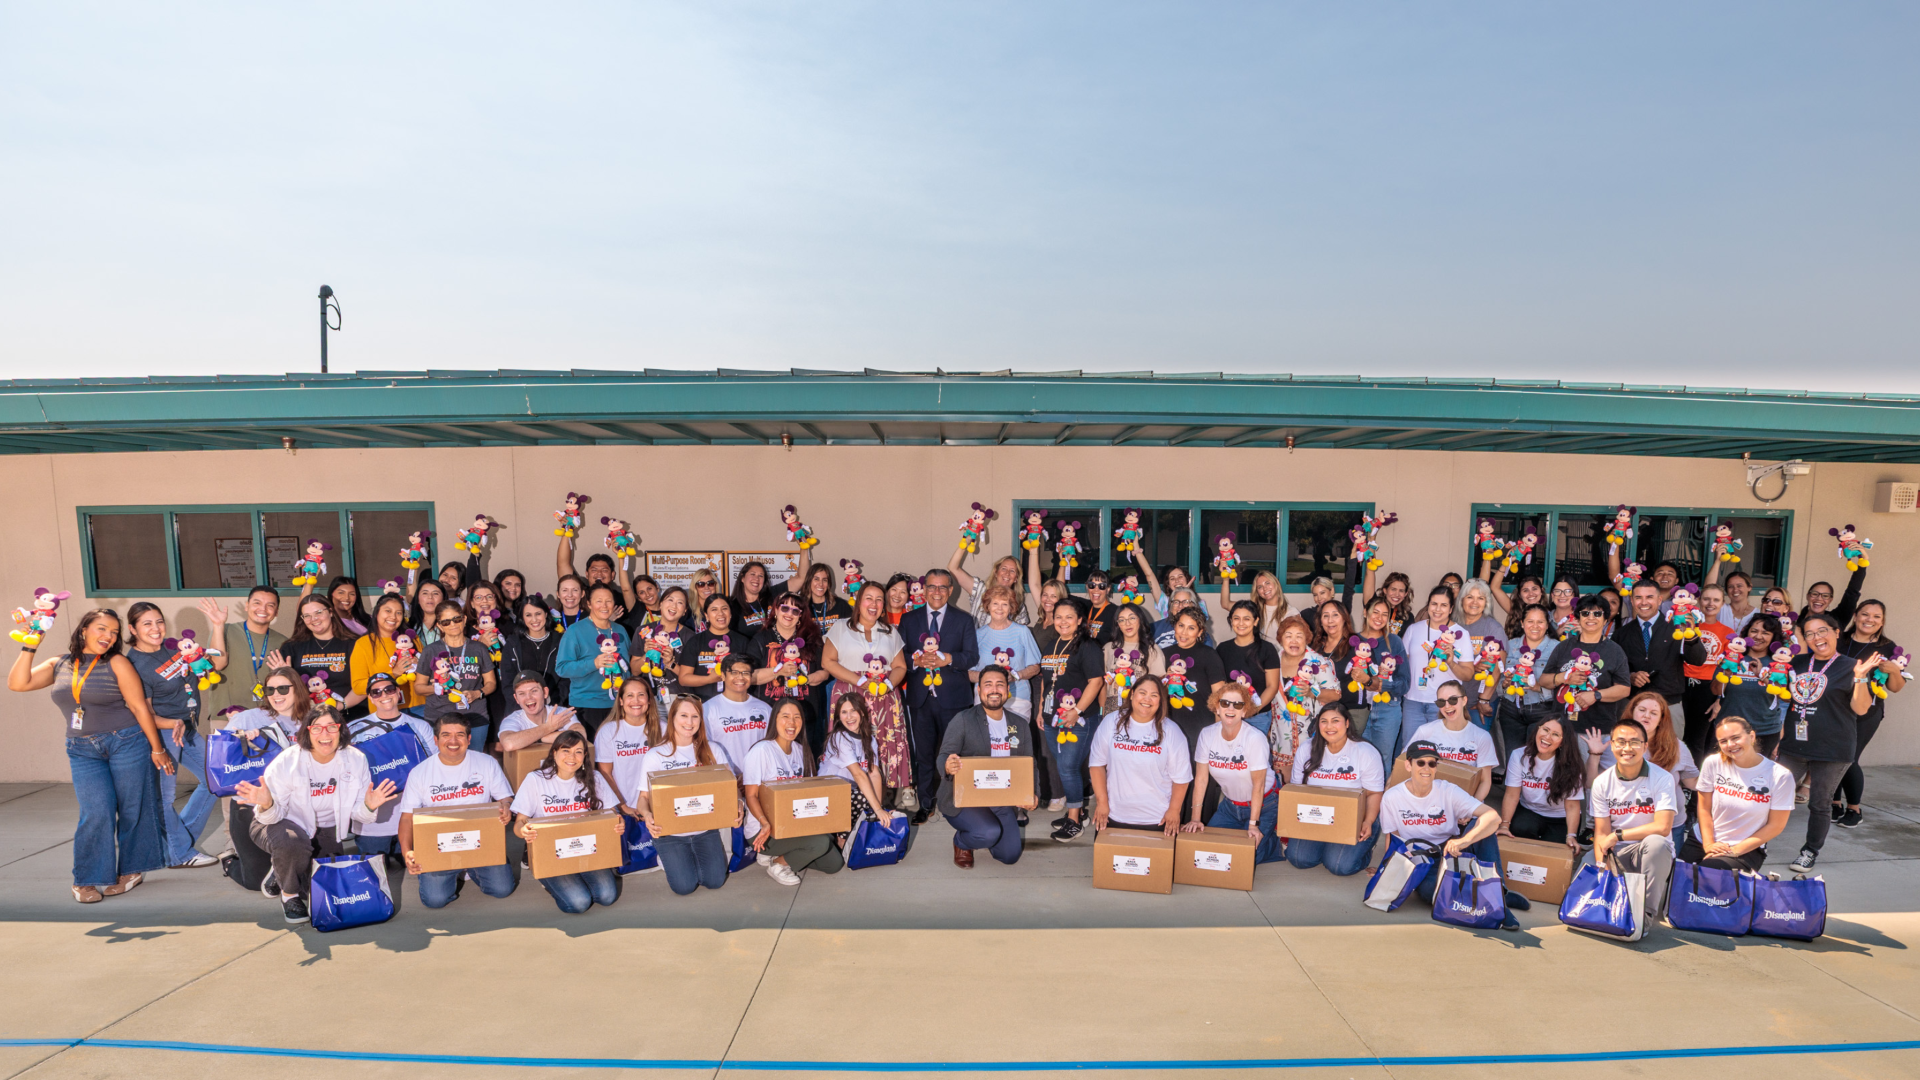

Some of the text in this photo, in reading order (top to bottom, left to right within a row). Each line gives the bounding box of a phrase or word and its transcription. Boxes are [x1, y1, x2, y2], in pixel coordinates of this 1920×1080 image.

[652, 556, 706, 566] Multi-Purpose Room
[732, 556, 748, 565] Salon
[723, 721, 767, 734] VOLUNTEARS
[1114, 743, 1162, 754] VOLUNTEARS
[223, 758, 265, 774] Disneyland
[370, 755, 408, 775] Disneyland
[431, 786, 484, 802] VOLUNTEARS
[866, 843, 897, 856] Disneyland
[331, 890, 370, 905] Disneyland
[1764, 909, 1805, 921] Disneyland
